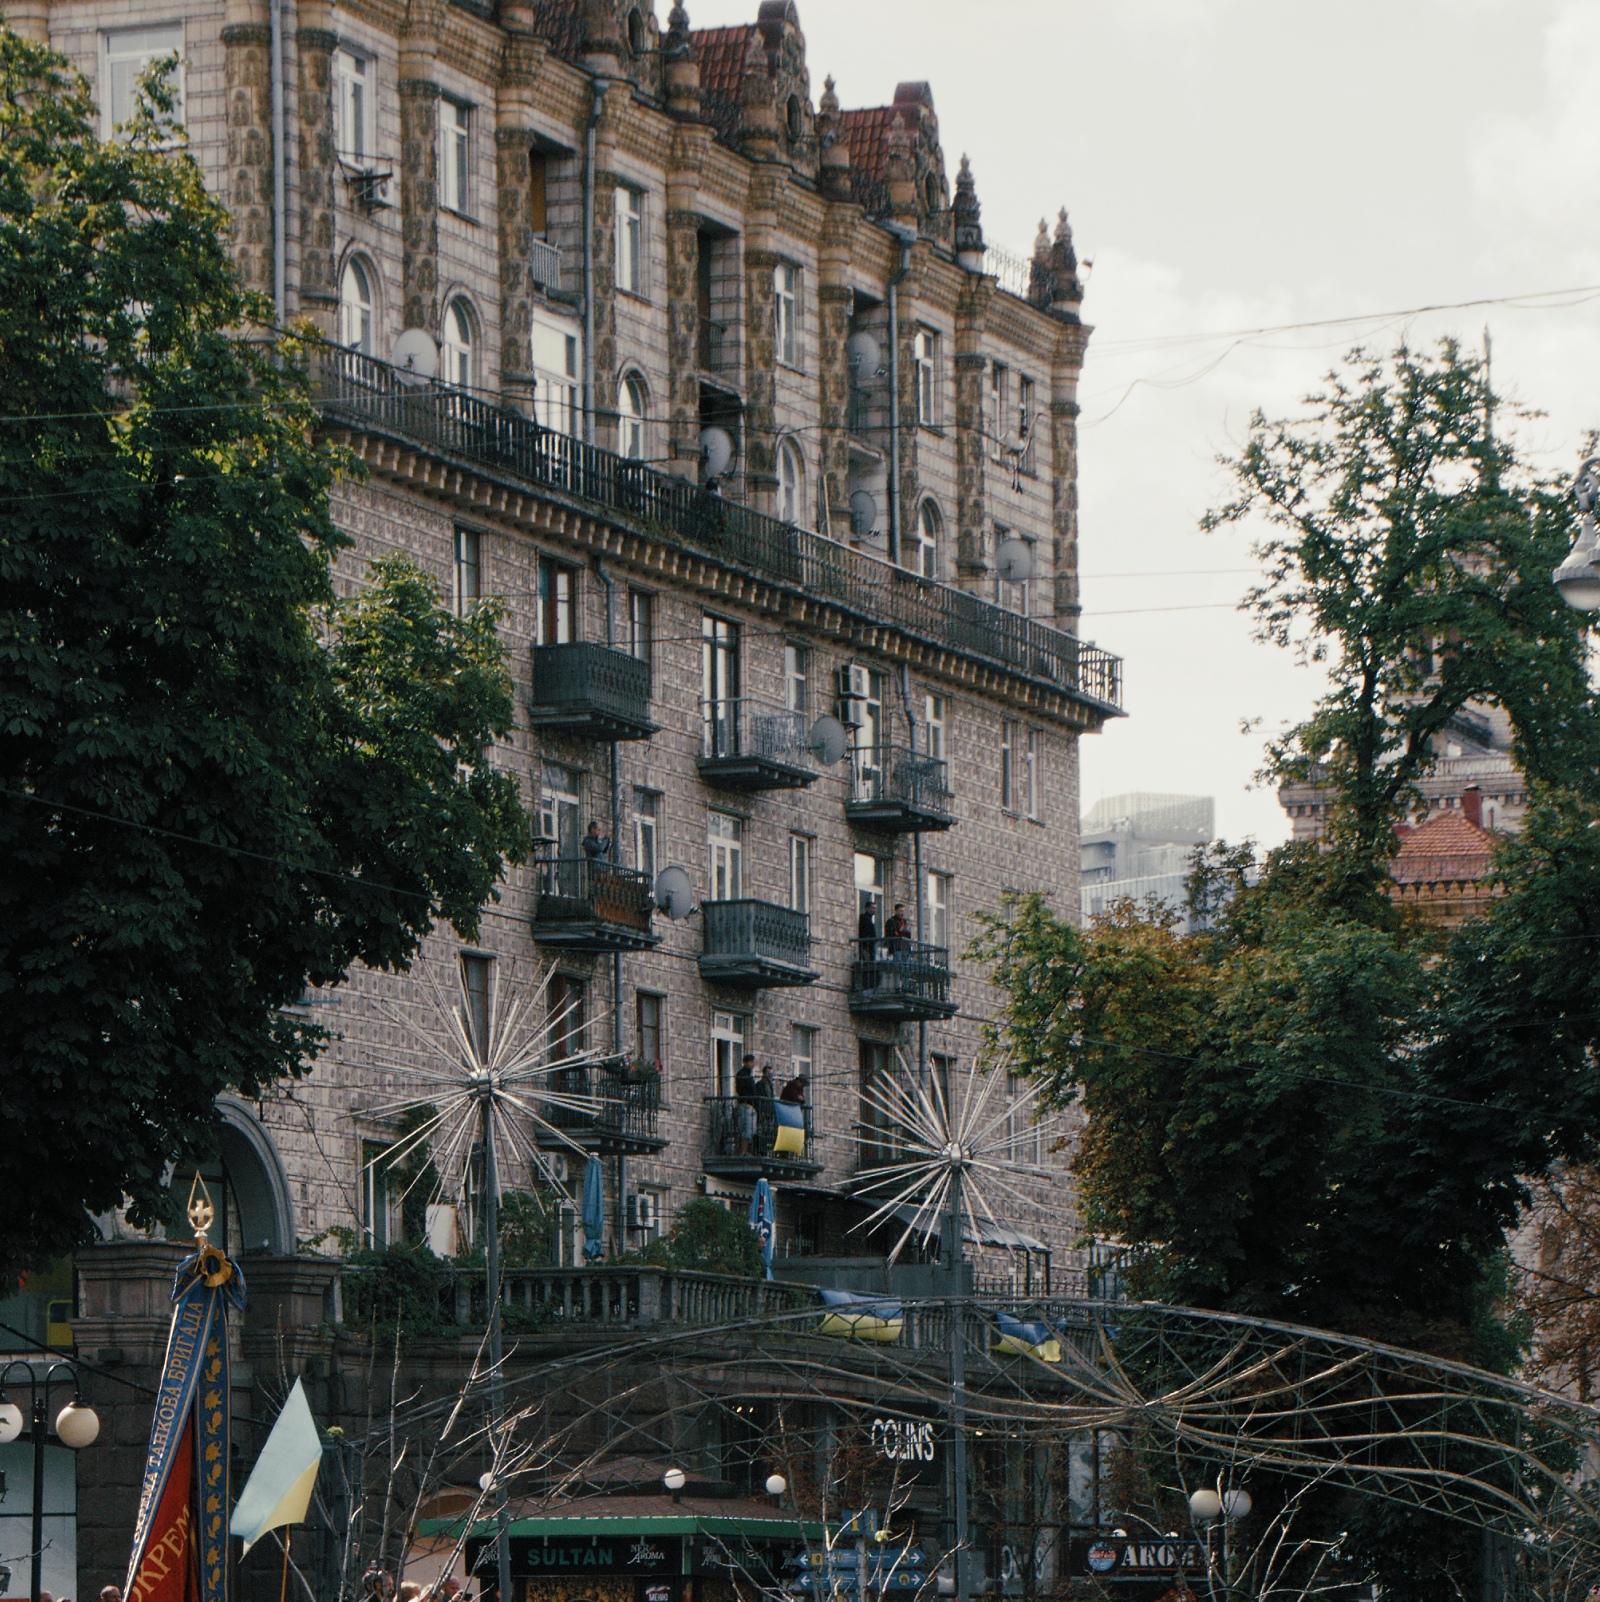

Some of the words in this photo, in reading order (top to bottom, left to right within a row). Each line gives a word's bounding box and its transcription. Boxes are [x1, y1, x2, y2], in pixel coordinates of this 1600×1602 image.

[148, 1386, 181, 1467] ТАНКОВА
[167, 1302, 204, 1382] БРИГАДА
[528, 1549, 613, 1566] SULTAN
[627, 1552, 665, 1564] AROMA
